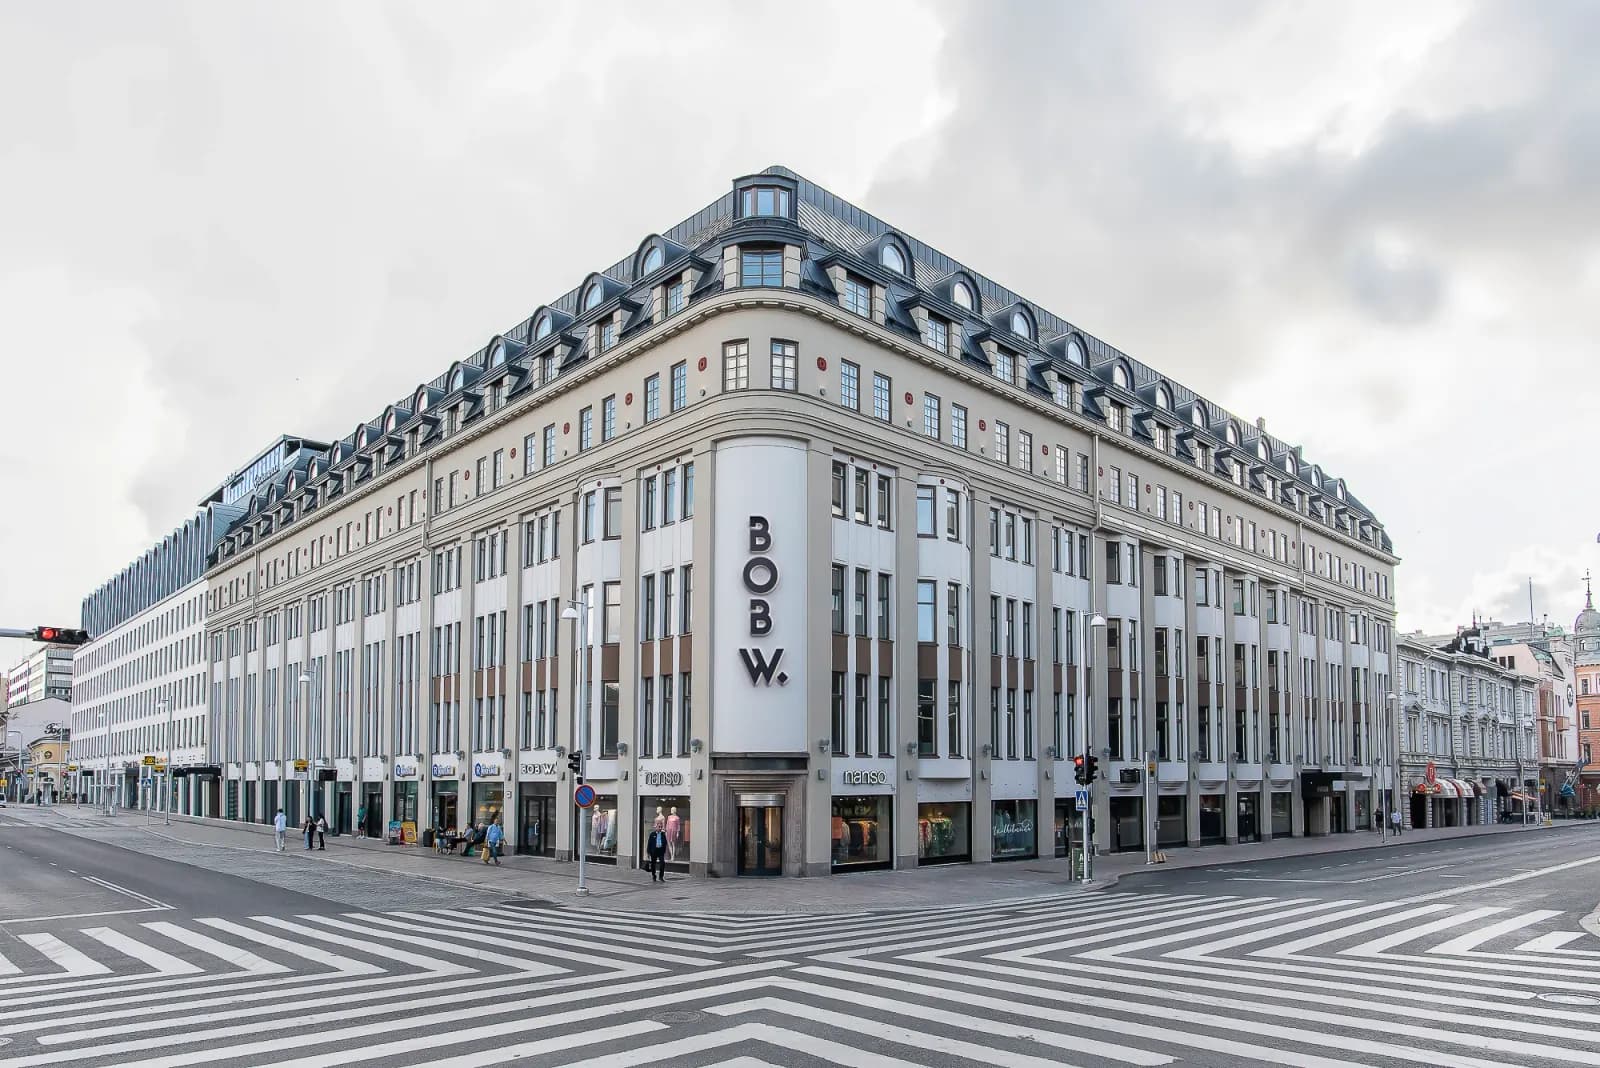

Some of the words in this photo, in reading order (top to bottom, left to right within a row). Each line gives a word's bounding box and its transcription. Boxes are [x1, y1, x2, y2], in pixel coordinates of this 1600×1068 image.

[520, 763, 541, 775] BOB
[645, 771, 684, 786] nanso
[843, 770, 887, 785] nanso
